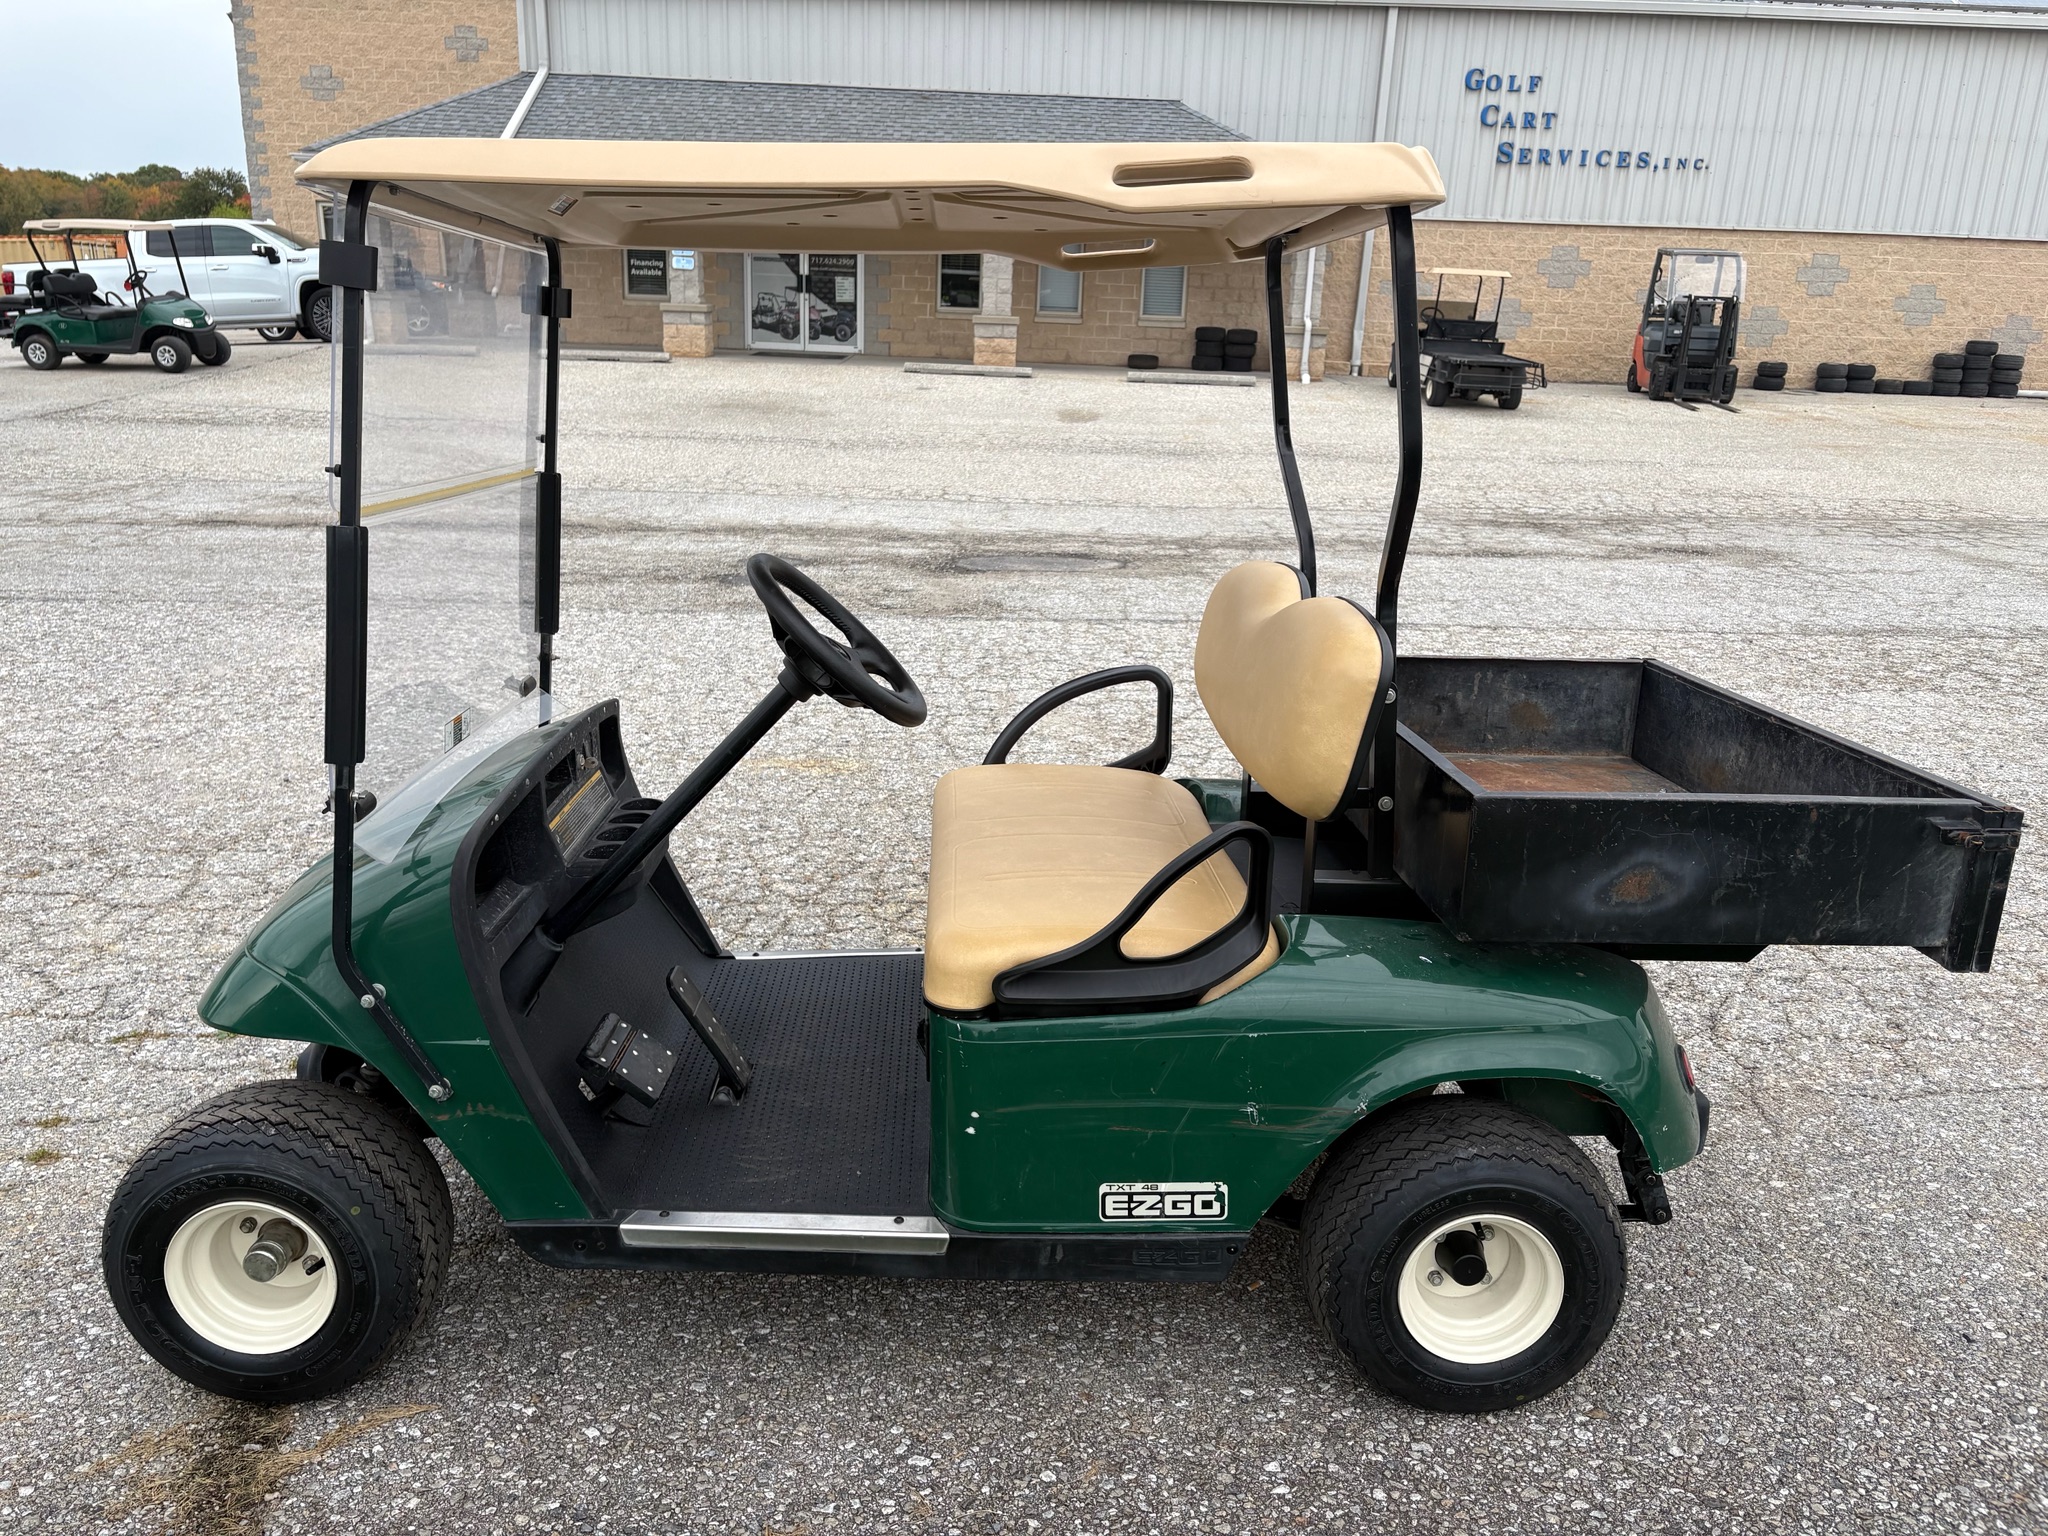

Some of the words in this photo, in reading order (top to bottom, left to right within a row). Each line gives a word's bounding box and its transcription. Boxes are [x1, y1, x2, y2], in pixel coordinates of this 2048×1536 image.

[1464, 68, 1543, 93] GOLF
[1480, 104, 1558, 130] CART
[630, 259, 664, 269] Financing
[630, 268, 662, 276] Available
[1104, 1194, 1221, 1217] EZGO
[1132, 1248, 1222, 1266] EZGO
[1366, 1283, 1404, 1368] KENDA
